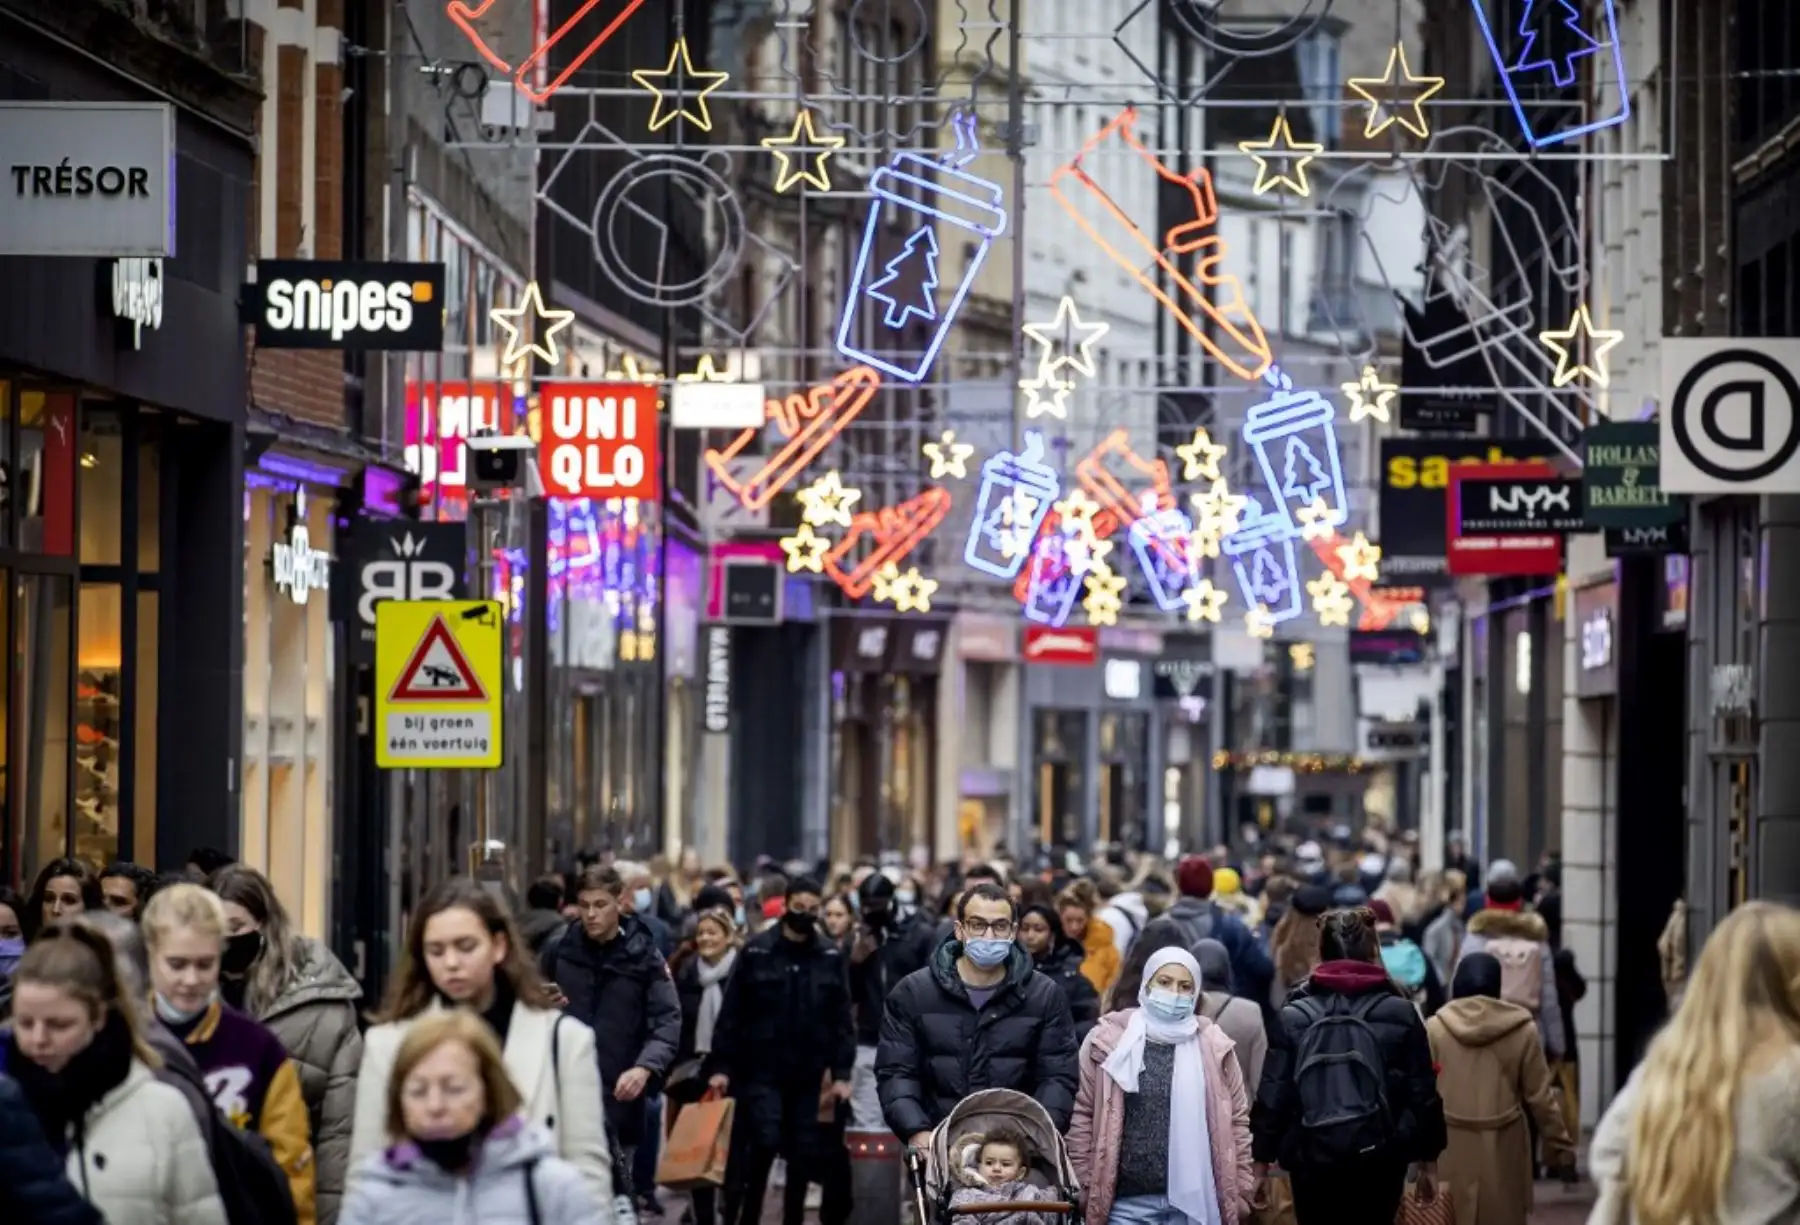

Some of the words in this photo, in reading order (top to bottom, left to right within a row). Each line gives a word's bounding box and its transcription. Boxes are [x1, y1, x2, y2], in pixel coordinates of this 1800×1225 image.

[11, 157, 149, 197] TRÉSOR
[266, 279, 412, 341] snipes
[552, 396, 637, 440] UNI
[551, 444, 644, 494] QLO
[1588, 446, 1660, 467] HOLLAN
[1622, 467, 1640, 487] &
[1489, 485, 1570, 519] NYX
[404, 716, 424, 732] bij
[430, 718, 474, 732] groen
[390, 737, 417, 750] één
[422, 737, 488, 752] voertuig
